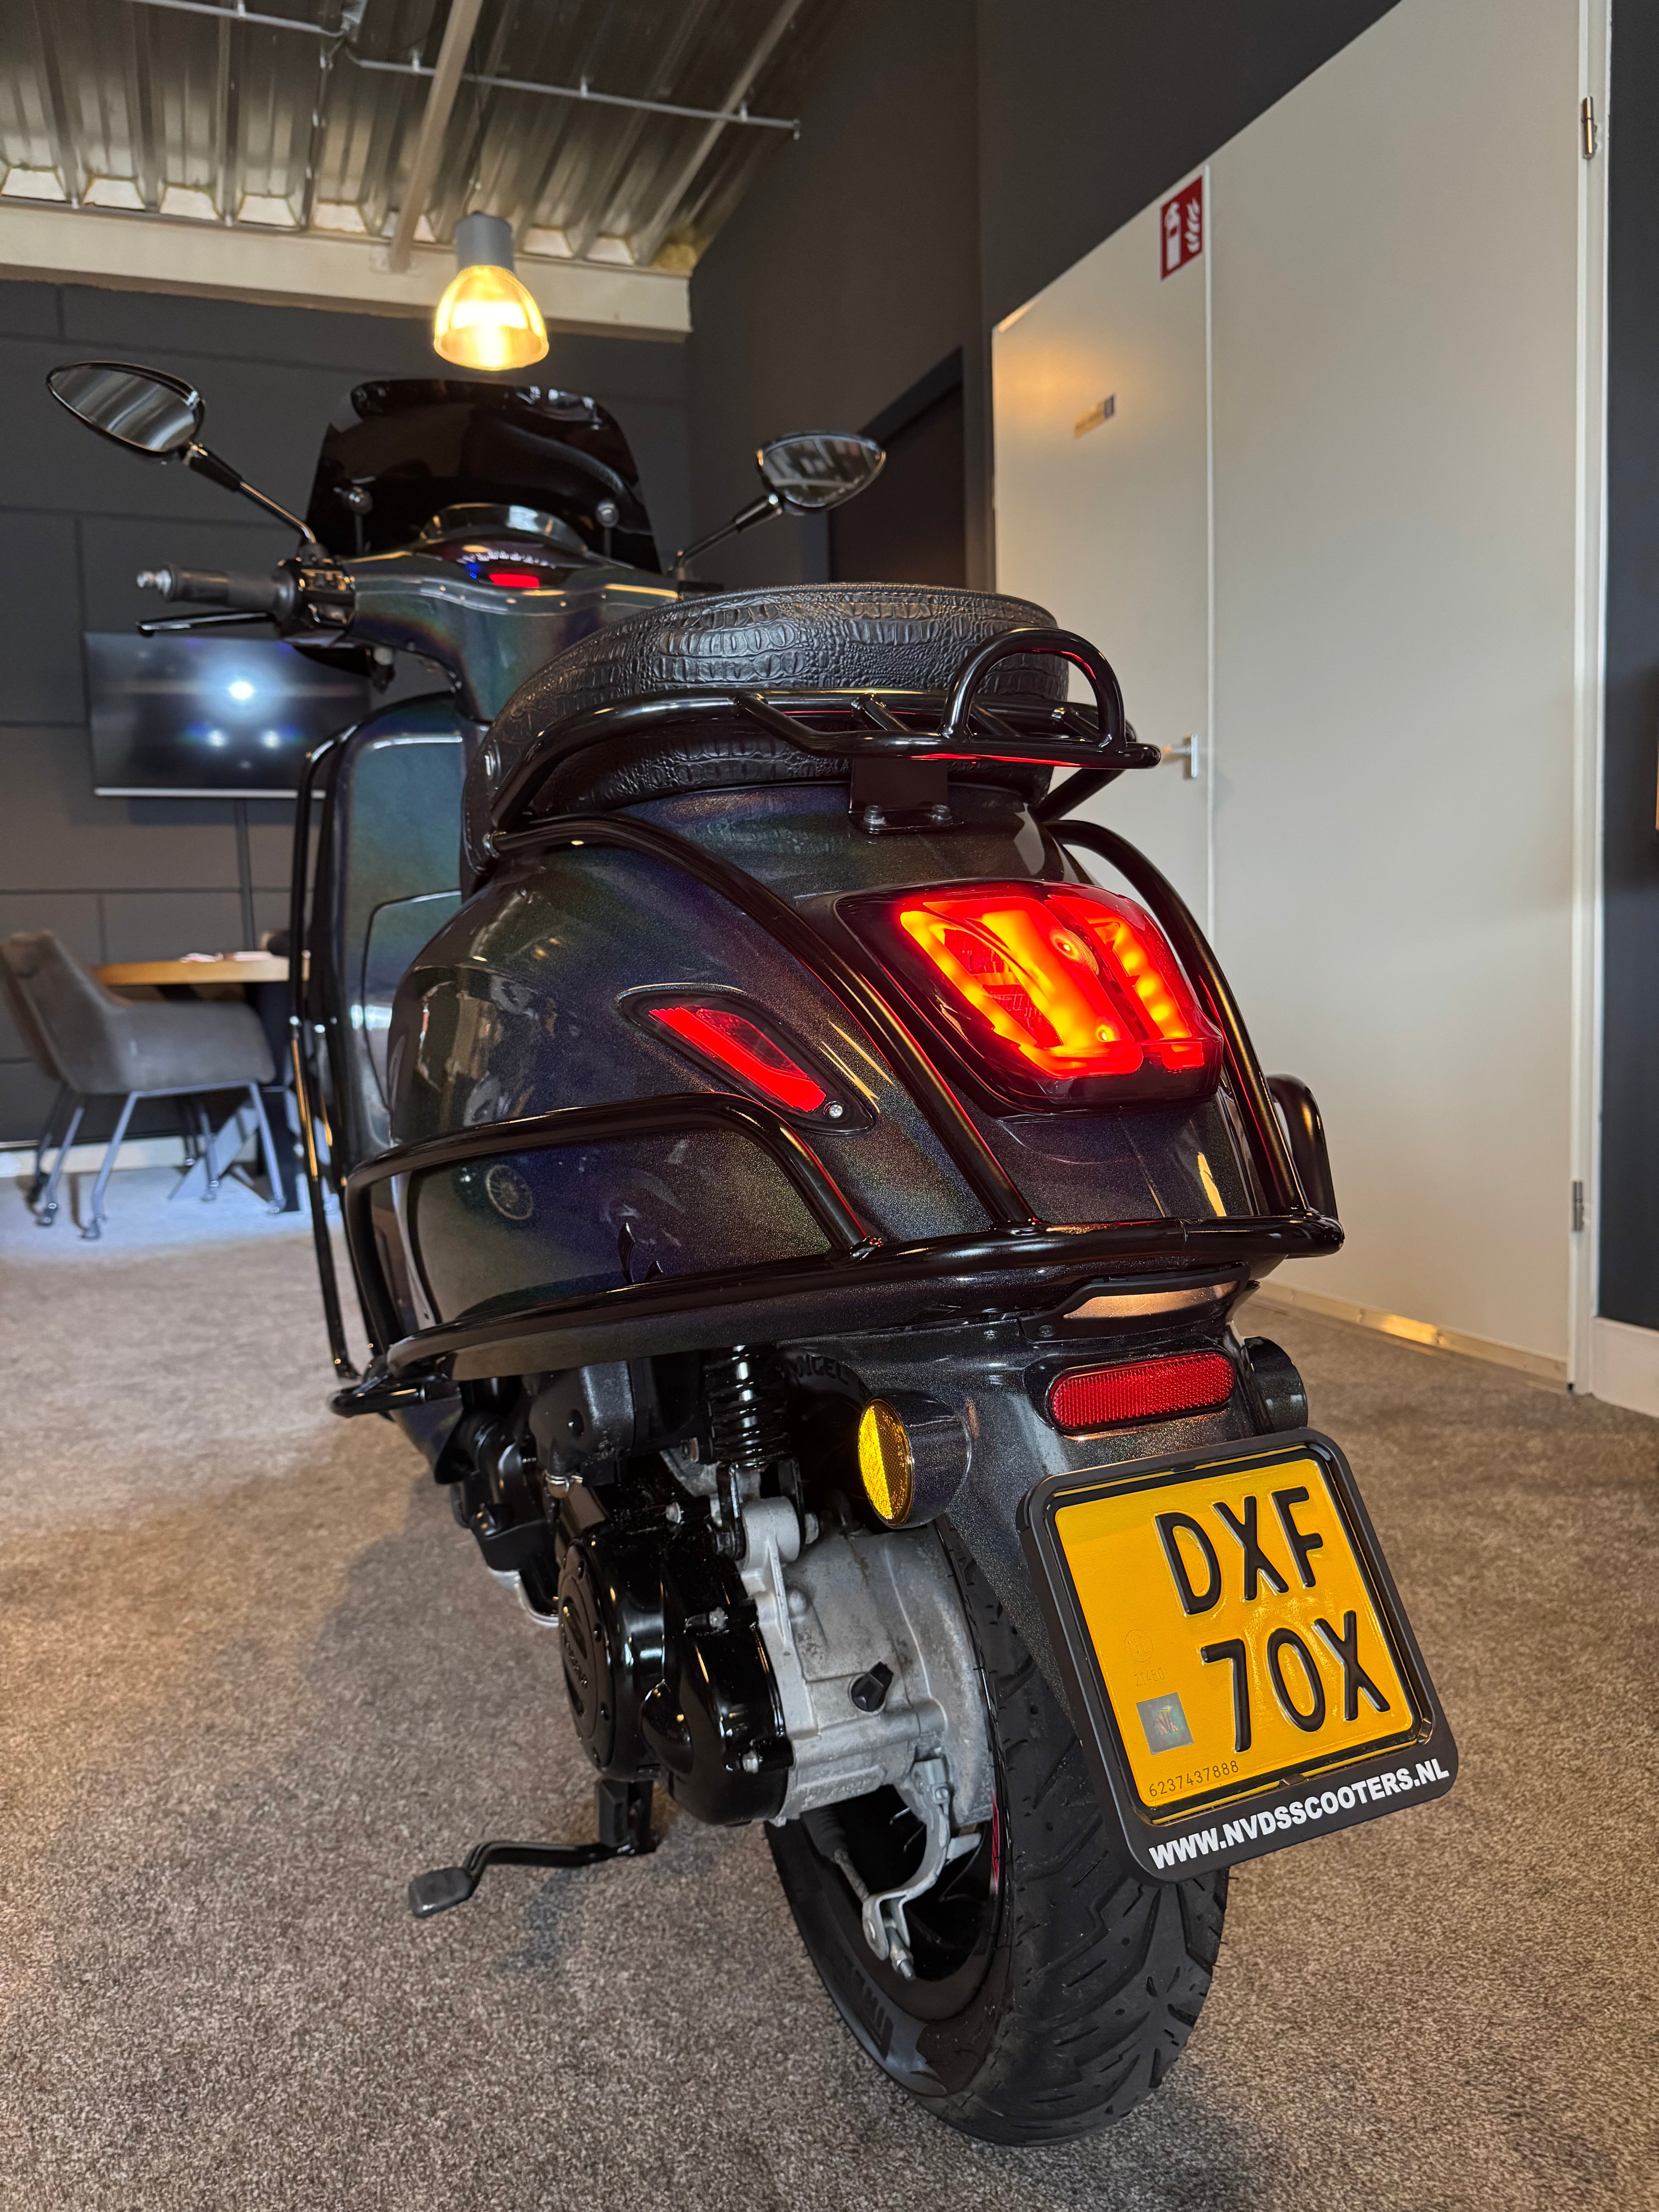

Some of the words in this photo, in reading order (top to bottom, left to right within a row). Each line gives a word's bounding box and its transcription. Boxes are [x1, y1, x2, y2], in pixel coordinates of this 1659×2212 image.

[1155, 1486, 1323, 1615] DXF
[1128, 1636, 1152, 1655] NL
[1200, 1610, 1391, 1752] 70X
[1148, 1758, 1449, 1870] WWW.NVDSSCOOTERS.NL
[1149, 1760, 1239, 1797] 6237437888
